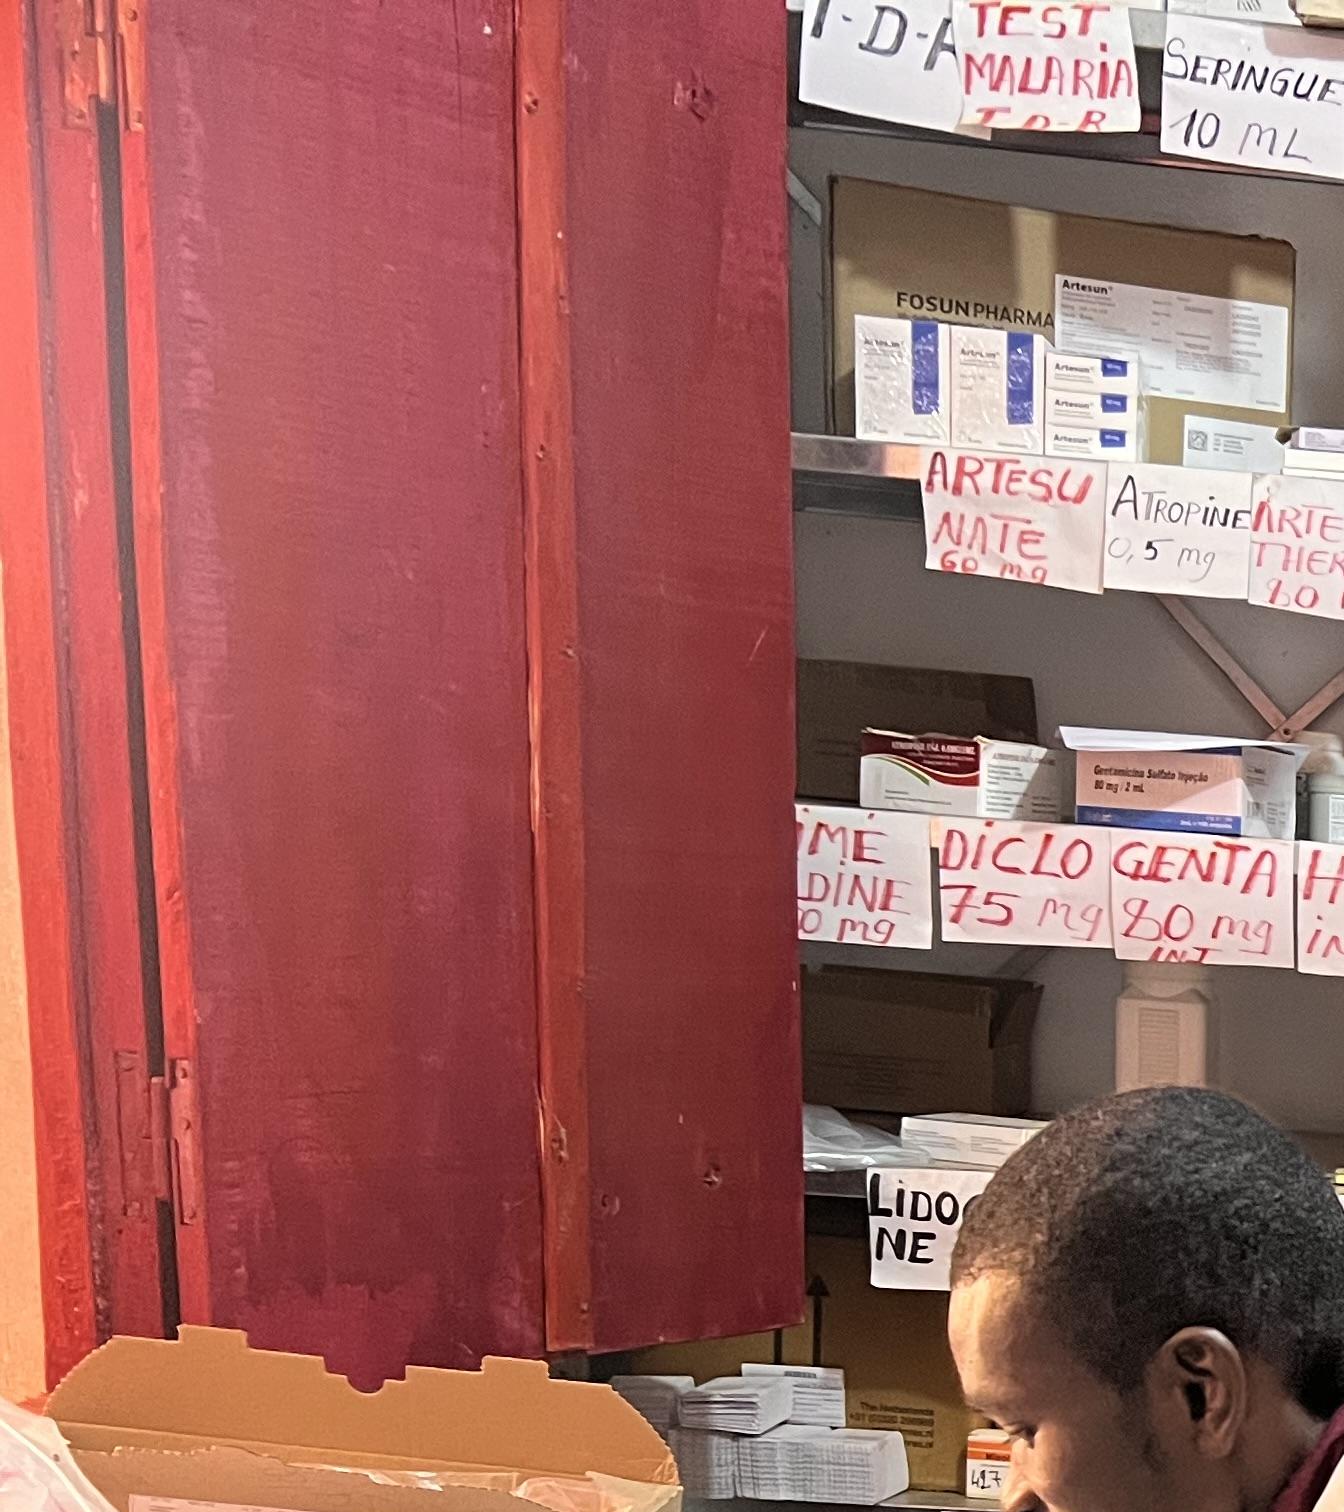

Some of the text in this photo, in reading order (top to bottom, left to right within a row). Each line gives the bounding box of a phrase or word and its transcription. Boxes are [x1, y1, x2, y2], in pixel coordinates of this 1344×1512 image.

[977, 3, 1097, 39] TEST
[963, 44, 1133, 100] MALARIA
[1181, 107, 1220, 149] 10
[896, 291, 1054, 328] FOSUN PHARMA
[926, 451, 1093, 504] ARTESU
[1112, 475, 1251, 530] ATROPINE
[933, 511, 1047, 560] NATE
[1108, 537, 1216, 581] 0,5 mg
[938, 820, 1095, 880] DICLO
[1111, 838, 1280, 898] GENTA
[837, 918, 895, 944] mg
[940, 884, 1105, 942] 75 mg
[1211, 913, 1273, 955] mg
[868, 1173, 959, 1225] LIDO
[875, 1227, 937, 1263] NE
